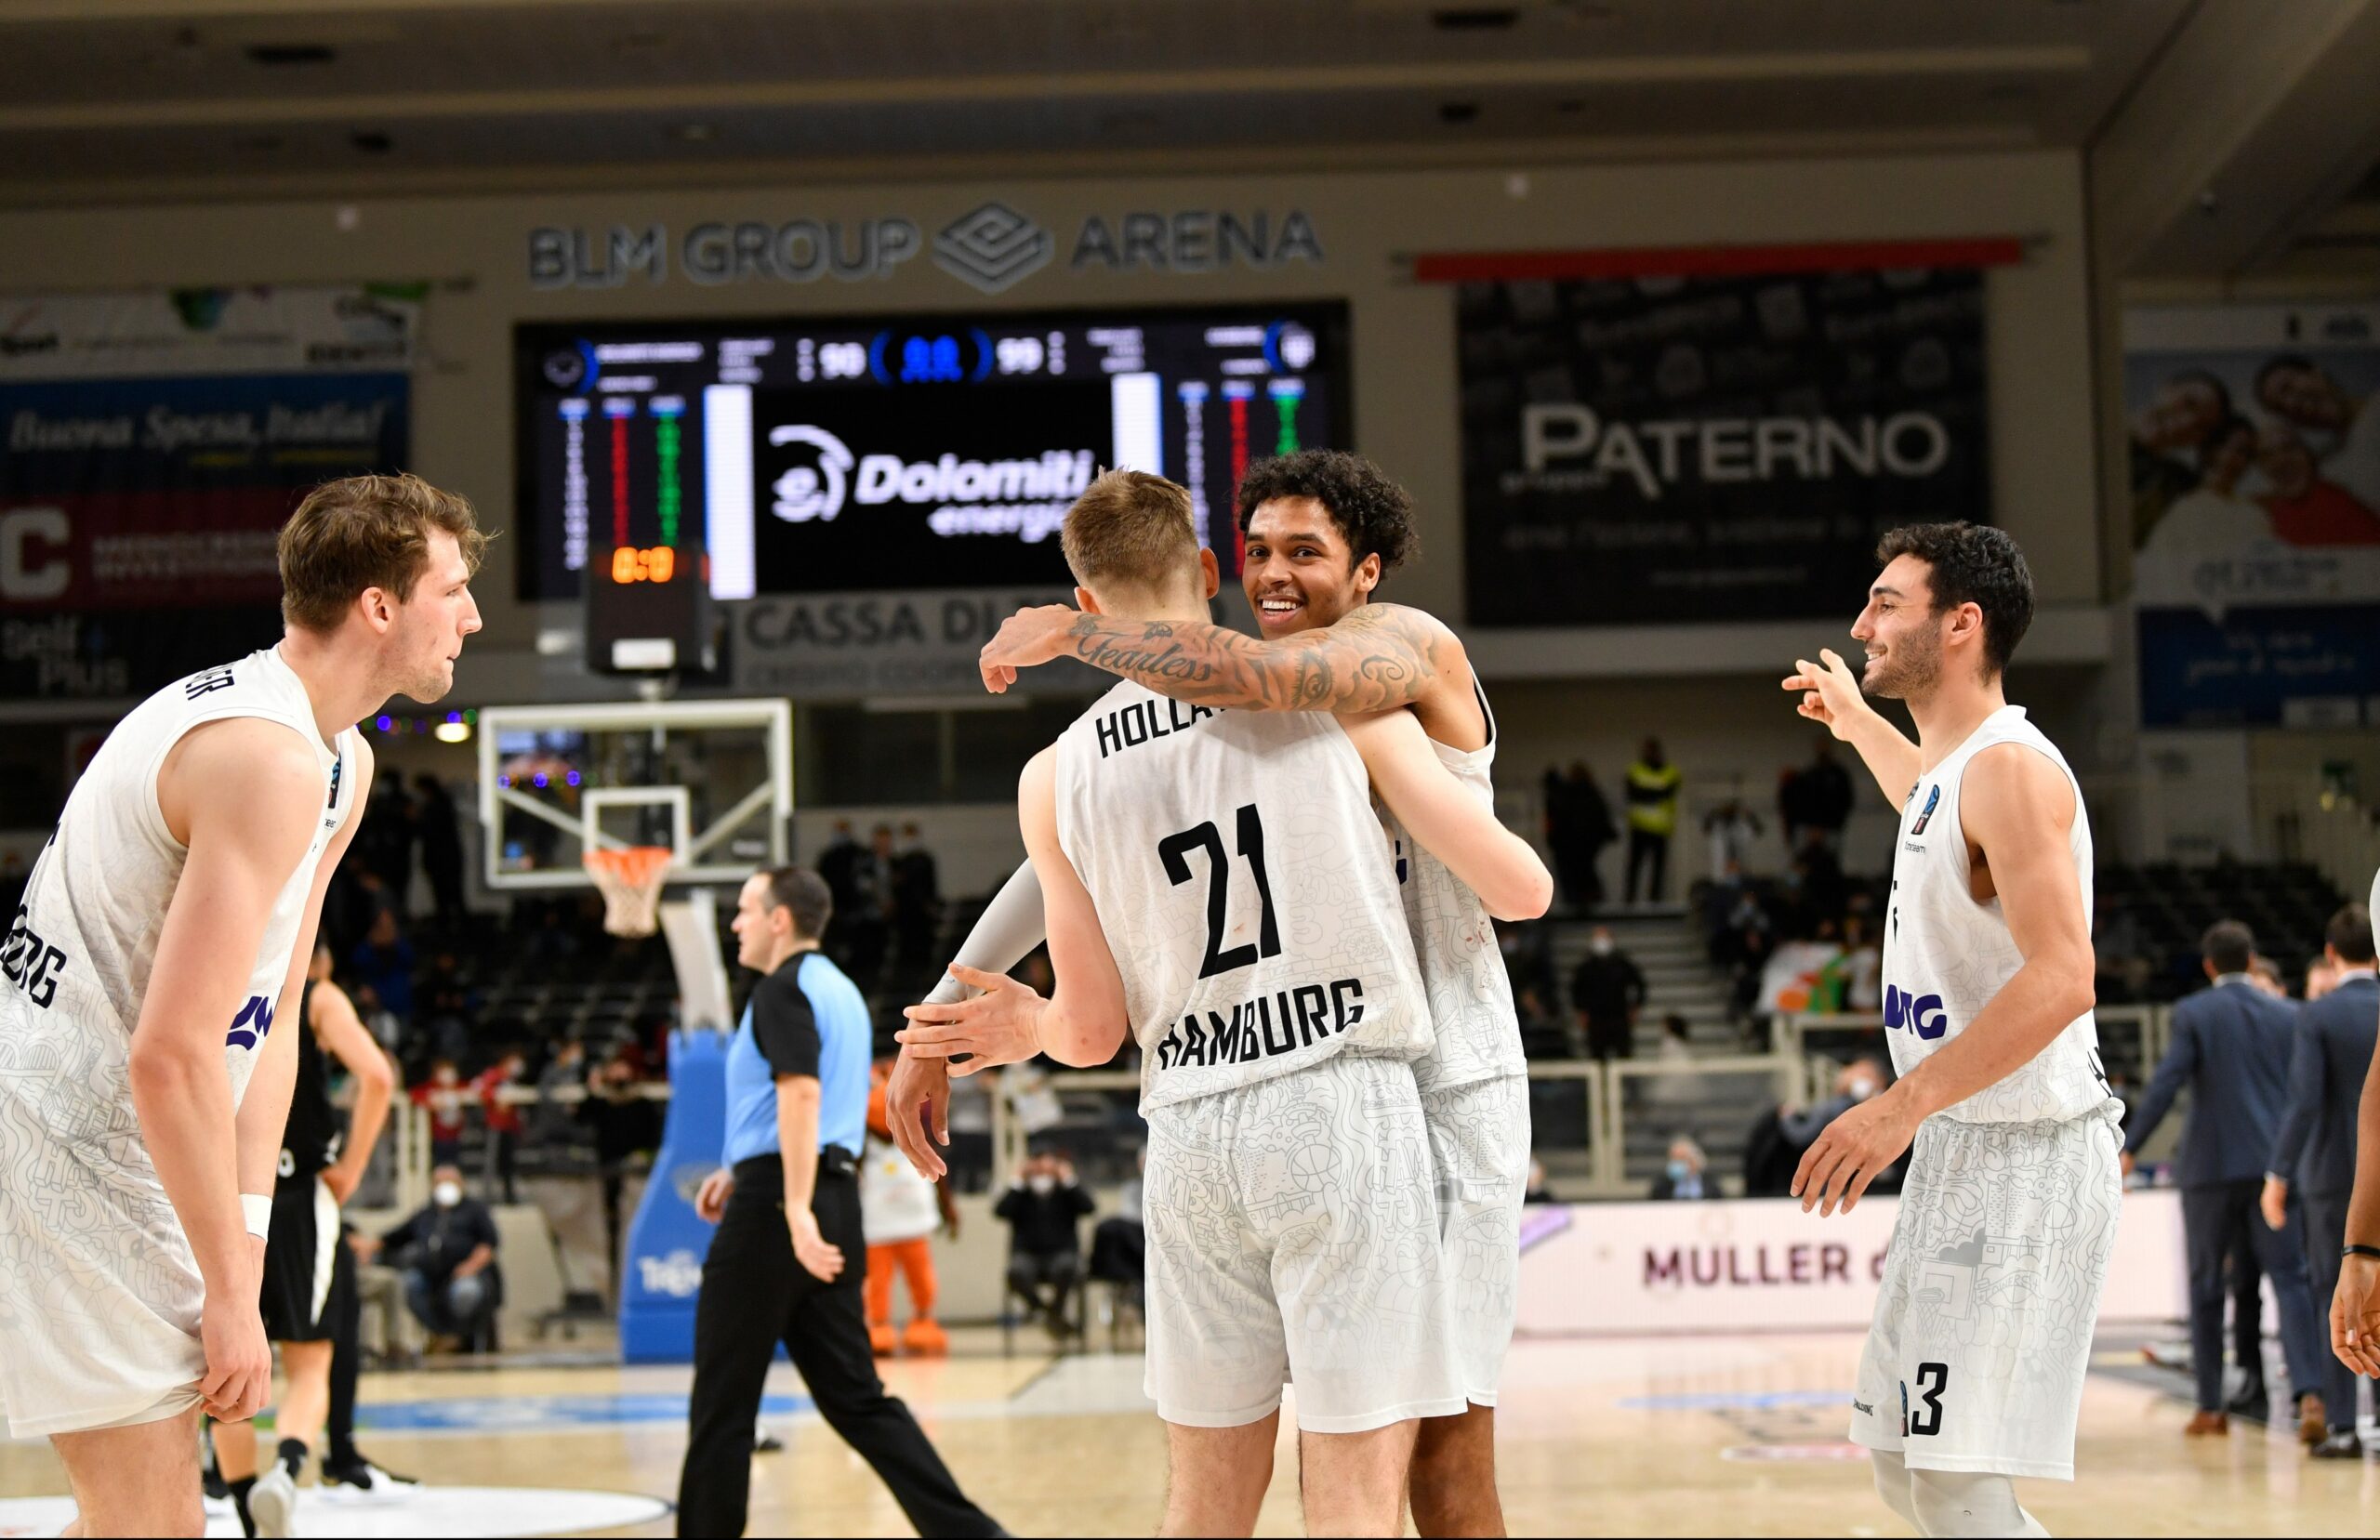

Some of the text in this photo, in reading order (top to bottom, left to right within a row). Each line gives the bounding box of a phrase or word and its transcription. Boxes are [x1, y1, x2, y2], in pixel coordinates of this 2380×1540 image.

[527, 207, 1325, 289] BLM GROUP ARENA
[854, 449, 1095, 504] Dolomiti
[1521, 402, 1951, 502] PATERNO
[746, 598, 927, 649] CASSA
[1078, 631, 1211, 681] Fearless
[1095, 697, 1227, 759] HOLLA
[1158, 803, 1281, 981] 21
[1157, 978, 1365, 1071] HAMBURG
[1643, 1244, 1851, 1287] MULLER
[1911, 1362, 1949, 1436] 3
